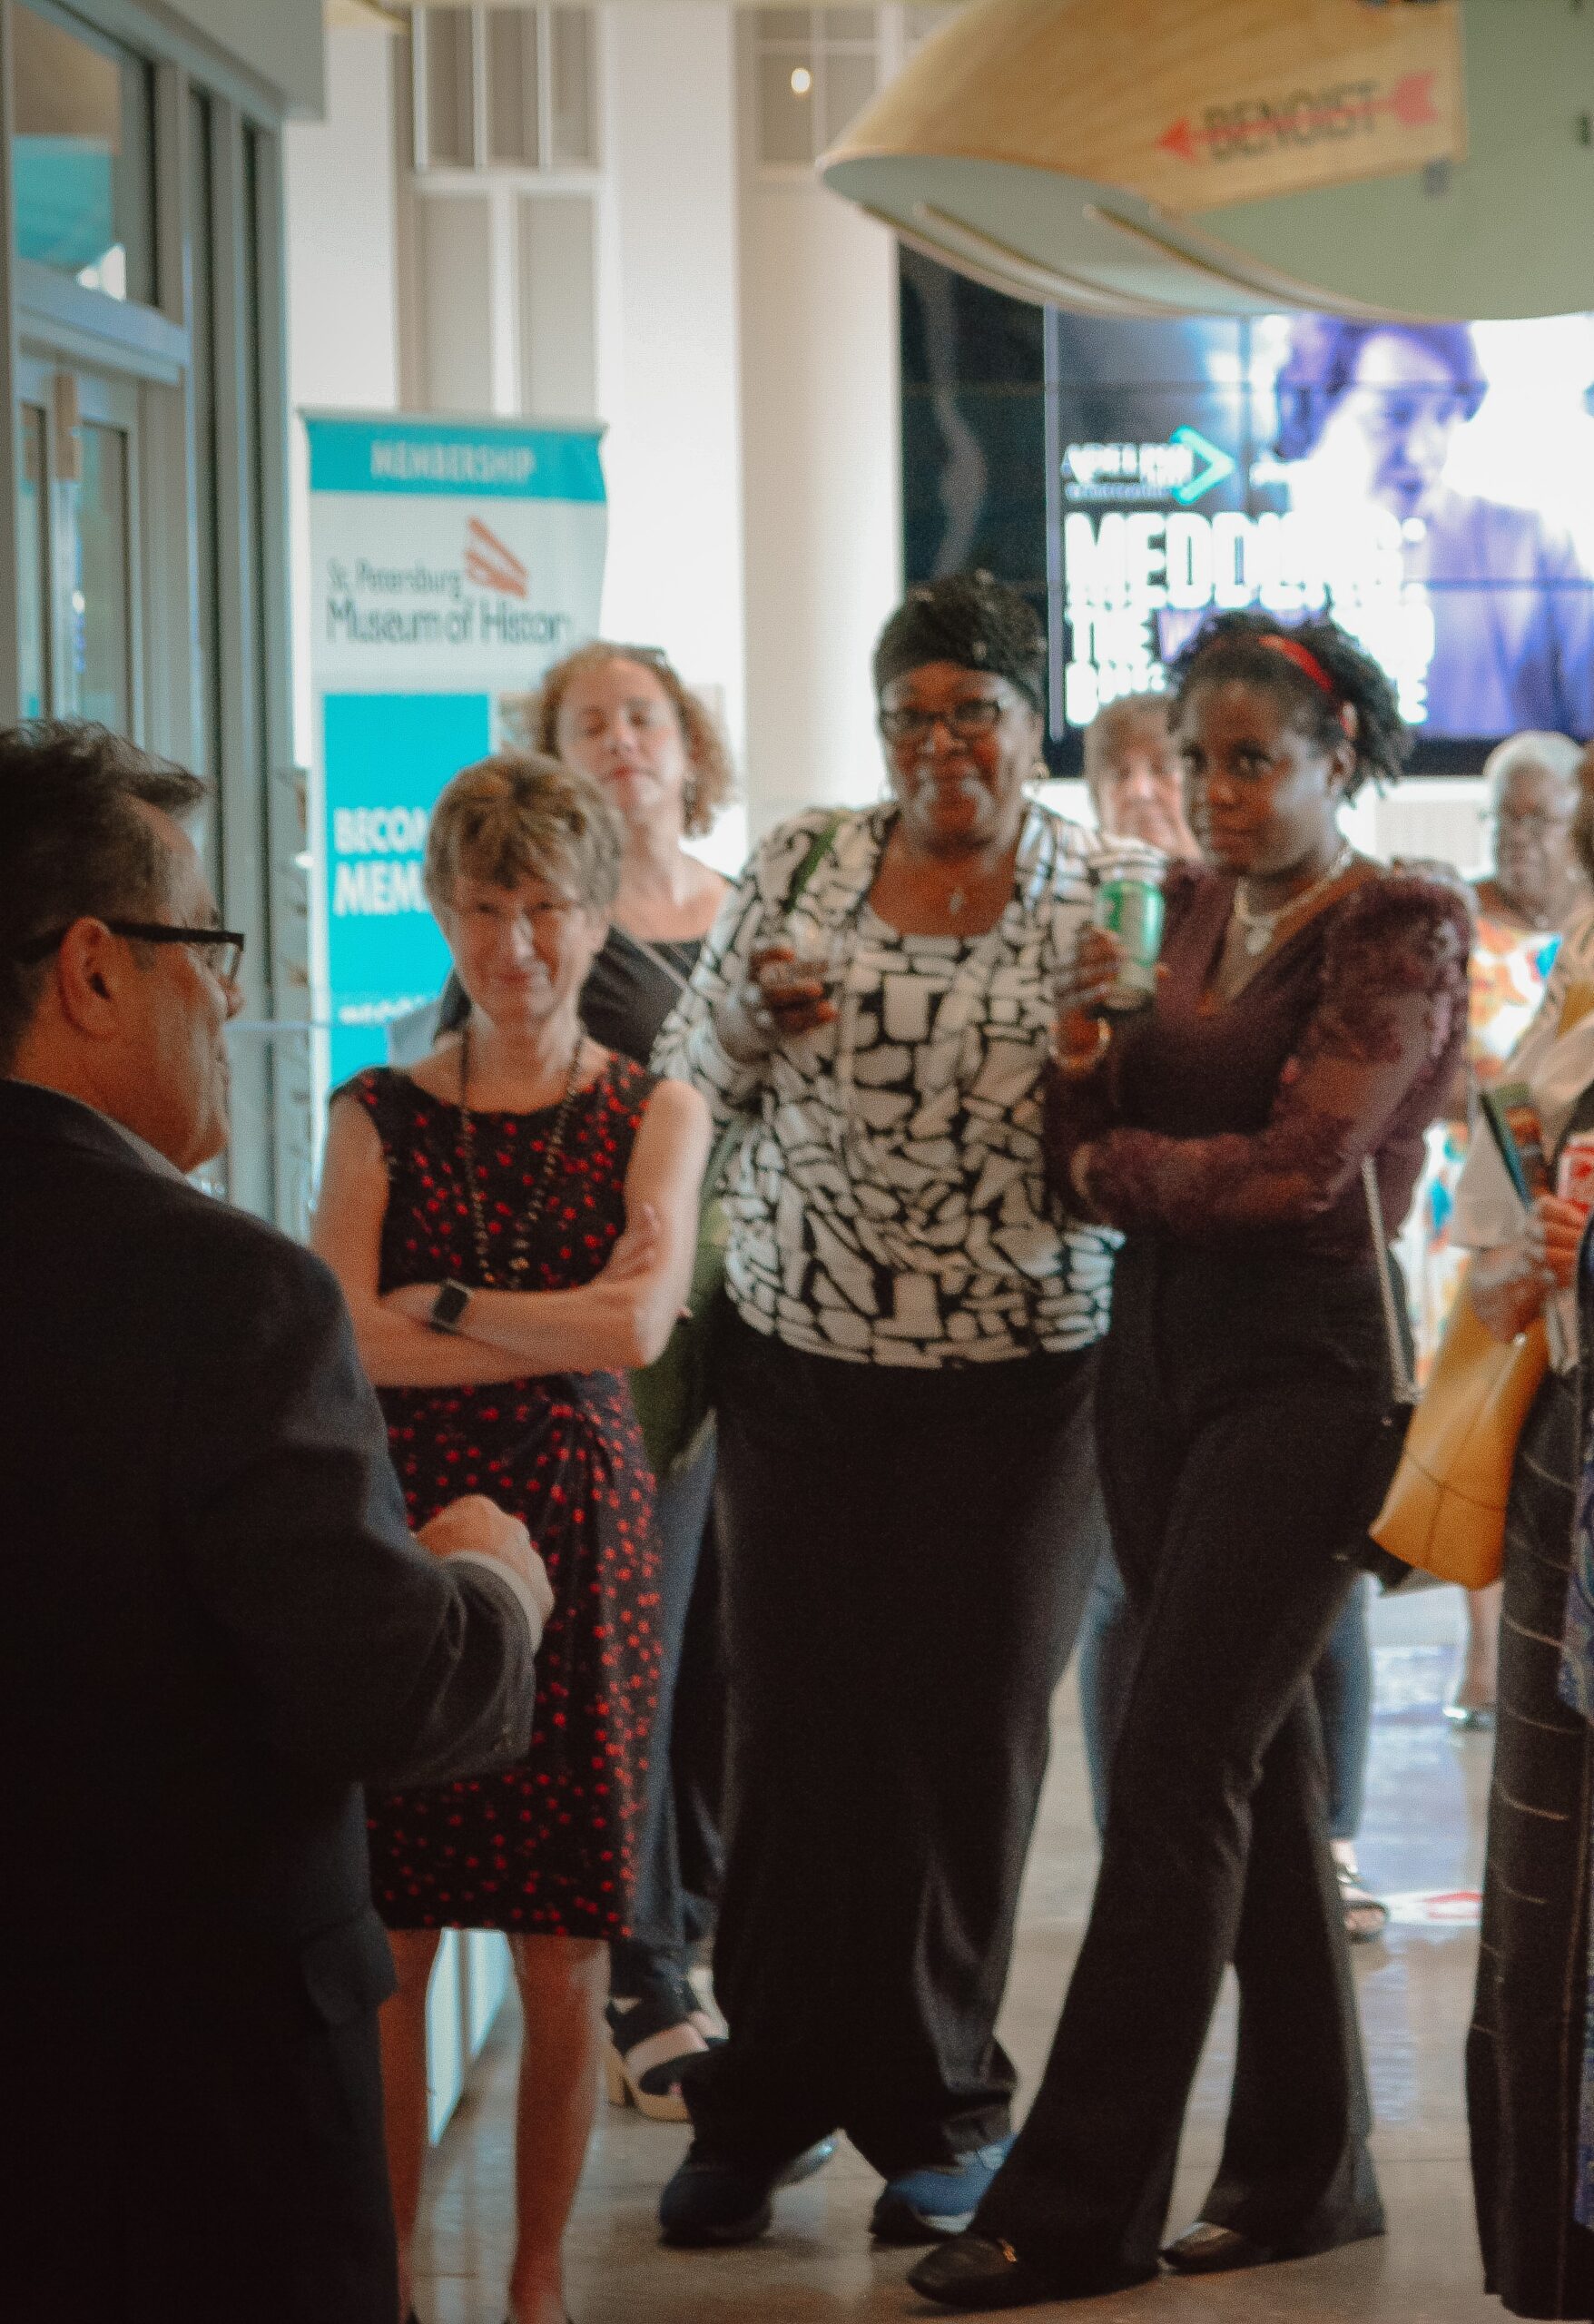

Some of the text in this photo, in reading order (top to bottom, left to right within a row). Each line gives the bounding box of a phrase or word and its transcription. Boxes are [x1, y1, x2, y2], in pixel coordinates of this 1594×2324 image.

[1204, 82, 1376, 161] BENOIST
[372, 442, 534, 482] MEMBERSHIP
[356, 558, 461, 599] Petersburg
[328, 598, 441, 642] Museum
[445, 596, 475, 644] of
